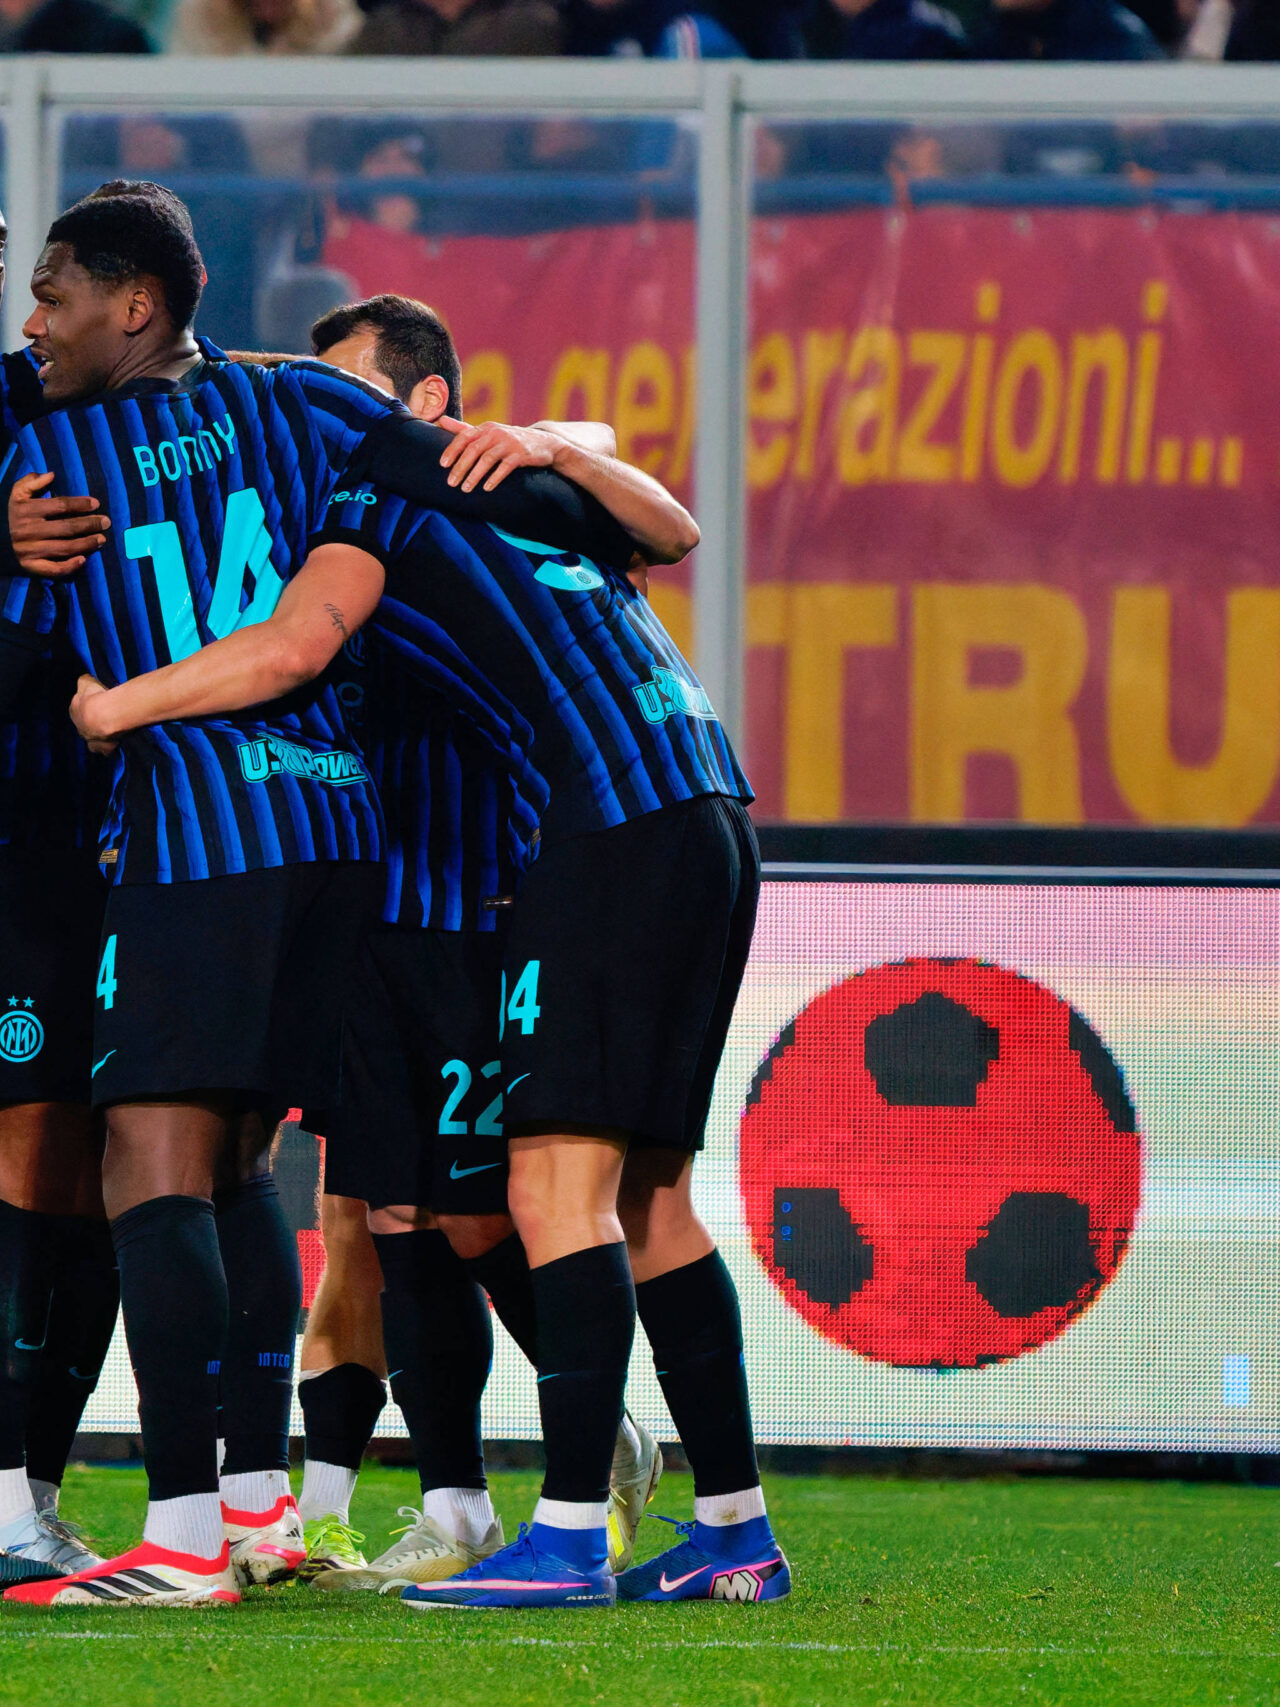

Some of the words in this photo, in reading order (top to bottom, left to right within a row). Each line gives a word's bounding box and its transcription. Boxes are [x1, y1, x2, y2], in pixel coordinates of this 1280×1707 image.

[132, 413, 237, 488] BONNY
[123, 487, 288, 664] 14
[642, 578, 1280, 828] TRU
[498, 959, 541, 1044] 4
[438, 1058, 504, 1136] 22
[258, 1352, 291, 1369] INTER
